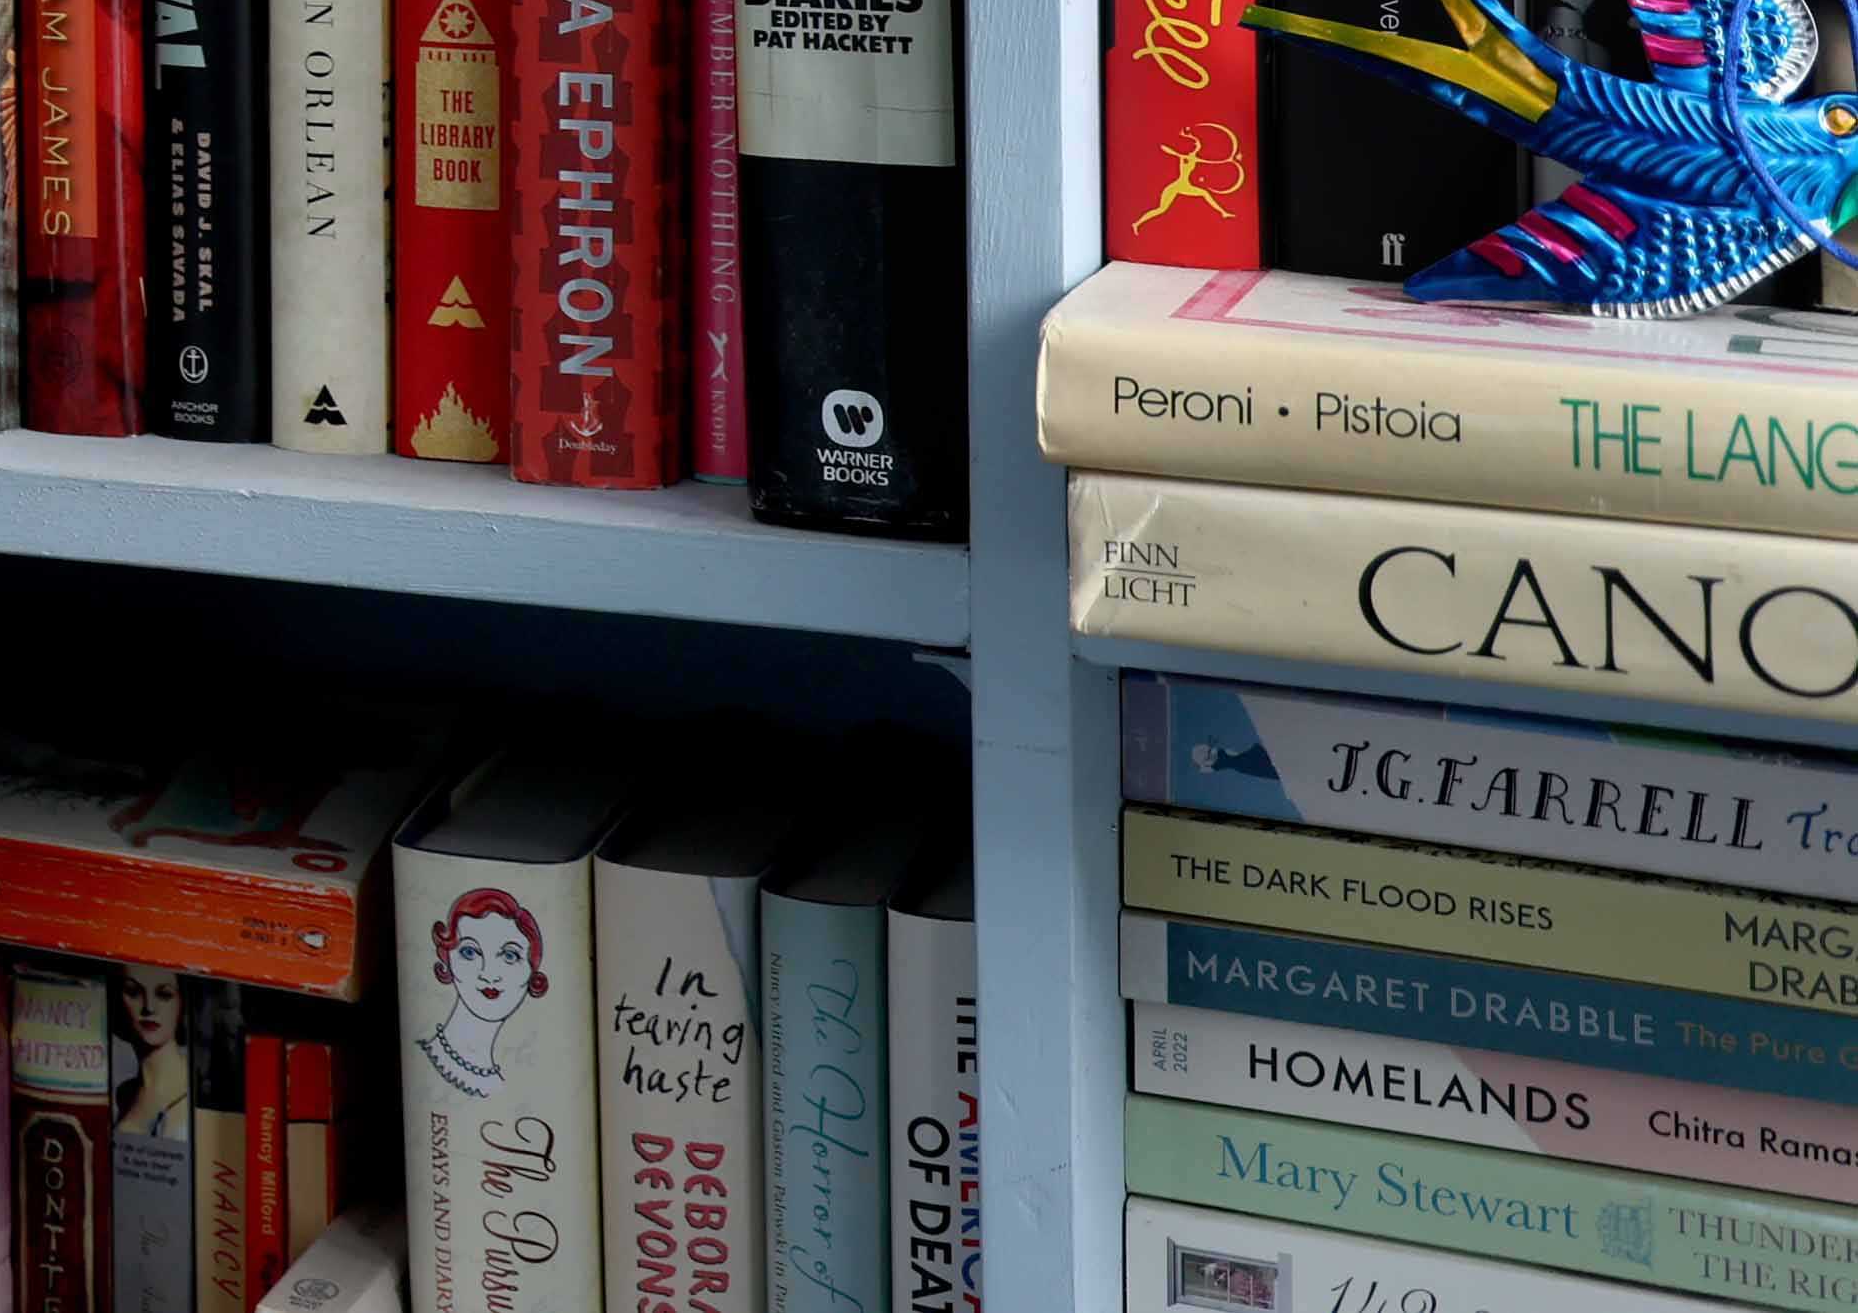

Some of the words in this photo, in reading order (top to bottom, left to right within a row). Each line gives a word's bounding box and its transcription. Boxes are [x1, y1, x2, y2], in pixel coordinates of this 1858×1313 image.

[753, 29, 797, 50] PAT
[803, 32, 913, 54] HACKETT
[771, 11, 854, 31] EDITED
[859, 13, 889, 34] BY
[440, 90, 474, 112] THE
[41, 68, 71, 235] JAMES
[303, 52, 336, 239] ORLEAN
[421, 124, 495, 149] LIBRARY
[434, 158, 482, 184] BOOK
[558, 72, 614, 377] EPHRON
[1114, 376, 1254, 426] Peroni
[1315, 393, 1462, 442] Pistoia
[1560, 398, 1661, 476] THE
[817, 449, 893, 470] WARNER
[823, 467, 888, 486] BOOKS
[1103, 541, 1180, 569] FINN
[1104, 576, 1194, 607] LICHT
[1439, 757, 1763, 852] FARRELL
[1170, 854, 1231, 885] THE
[1244, 864, 1331, 900] DARK
[1342, 878, 1455, 916] FLOOD
[1469, 898, 1553, 931] RISES
[656, 957, 718, 998] In
[1186, 951, 1428, 1013] MARGARET
[1451, 988, 1657, 1046] DRABBLE
[614, 994, 744, 1064] tearing
[622, 1047, 731, 1103] haste
[1248, 1043, 1592, 1131] HOMELANDS
[1649, 1110, 1744, 1150] Chitra
[1217, 1134, 1357, 1213] Mary
[1376, 1162, 1580, 1239] Stewart
